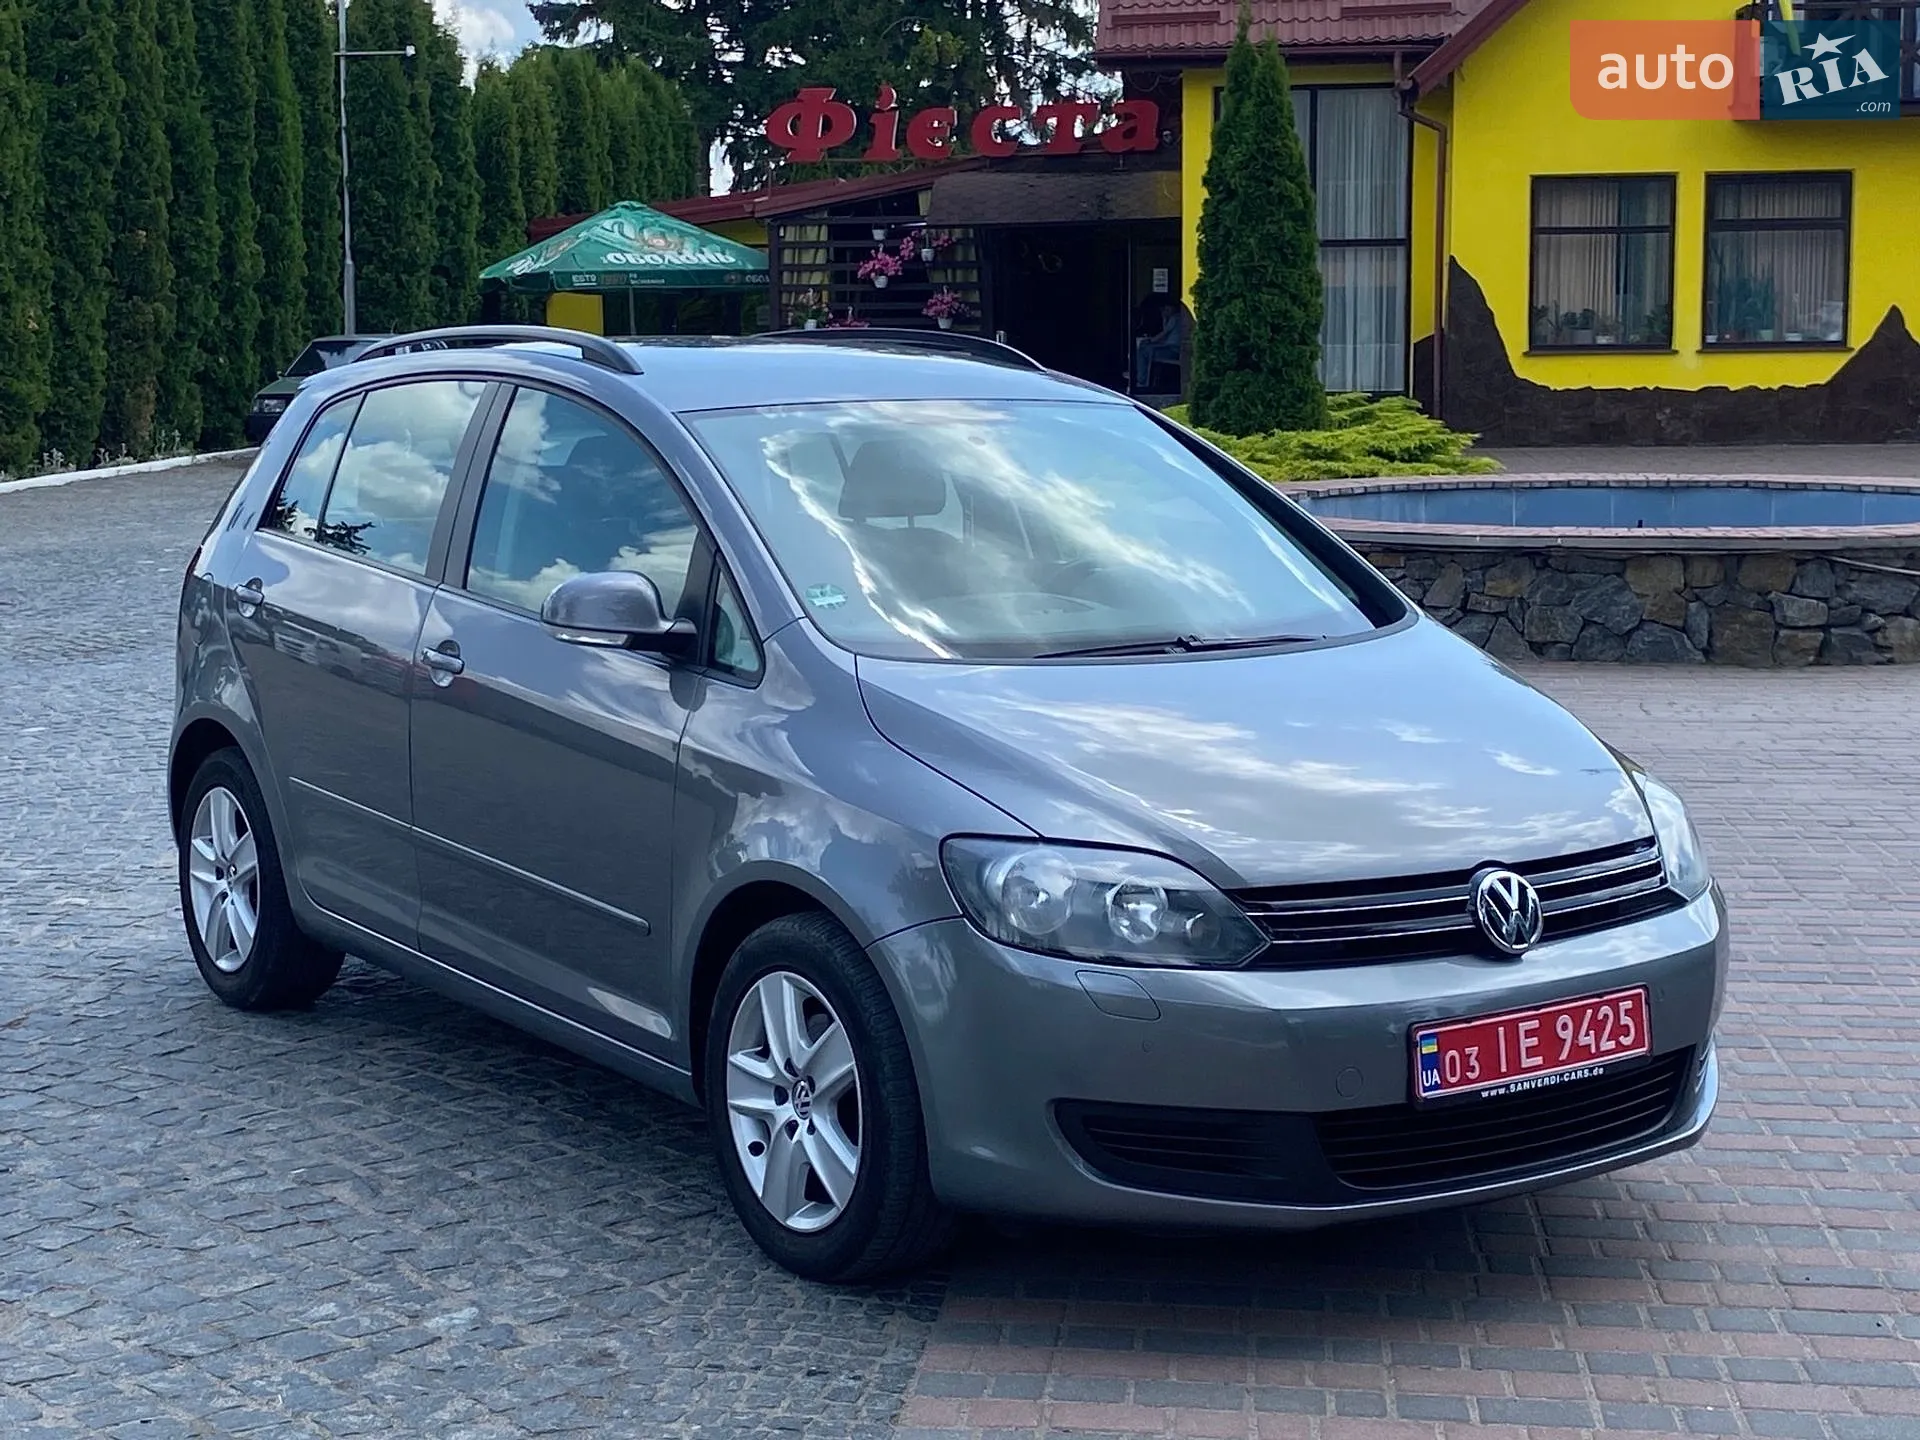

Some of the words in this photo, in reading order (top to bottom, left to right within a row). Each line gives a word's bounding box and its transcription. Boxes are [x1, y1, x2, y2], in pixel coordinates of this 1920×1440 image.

[765, 82, 1160, 163] Фієста
[1444, 1045, 1481, 1084] 03
[1497, 1020, 1543, 1073] IE
[1555, 1000, 1636, 1062] 9425
[1422, 1069, 1441, 1088] UA
[1481, 1067, 1604, 1098] www.SANVERDI-CARS.de
